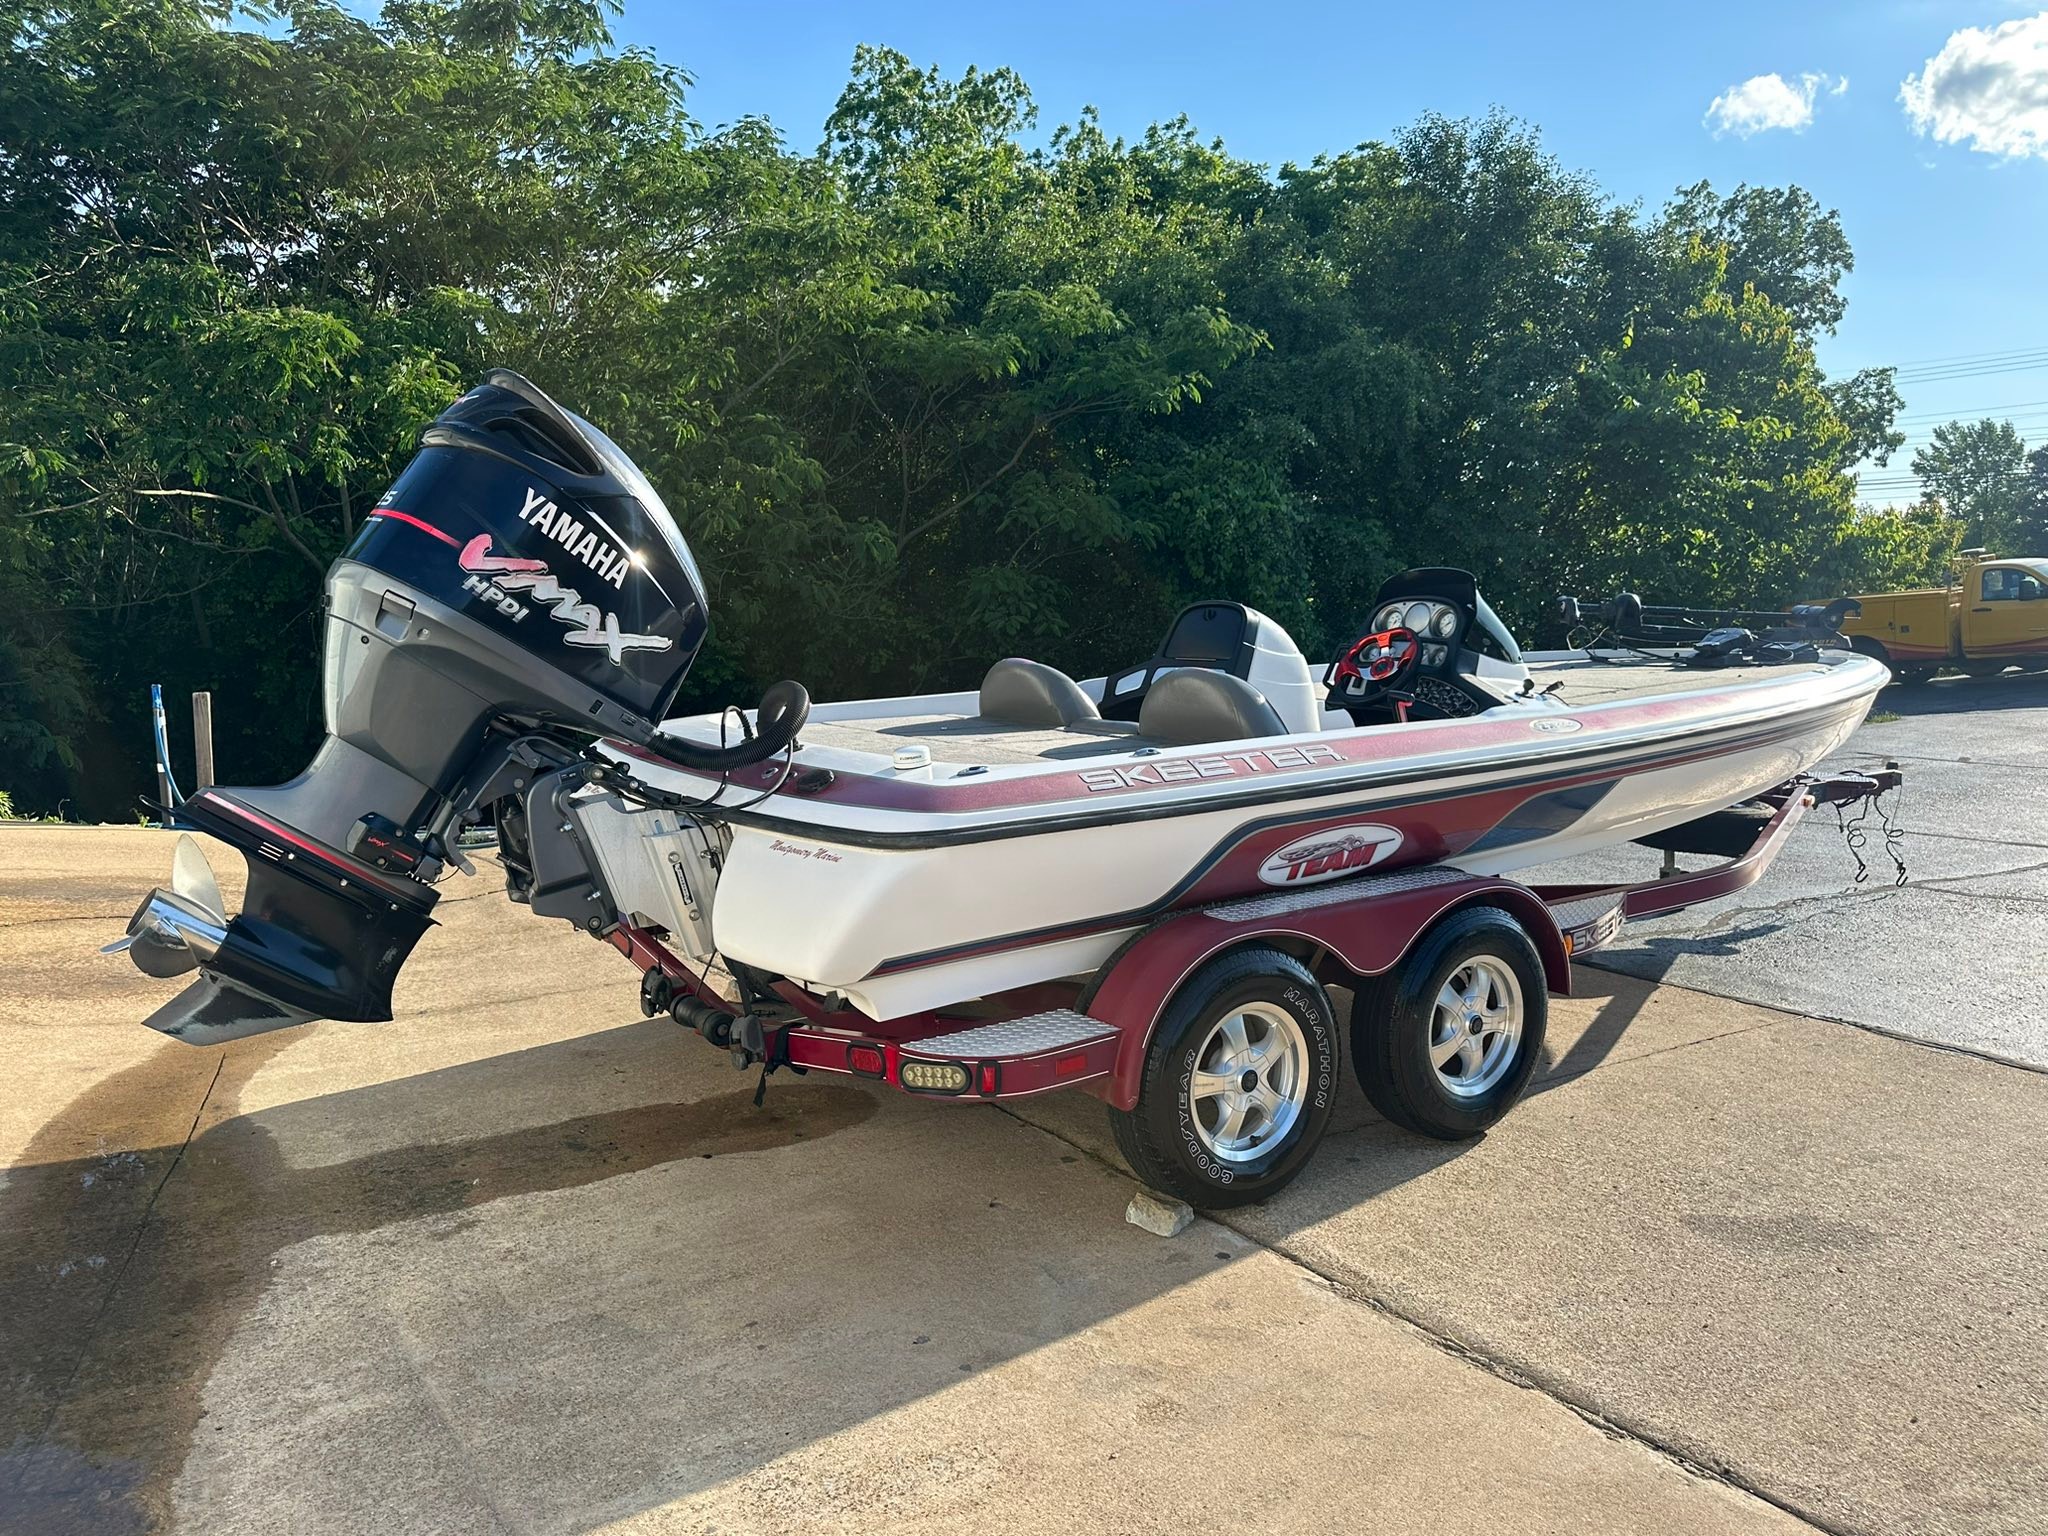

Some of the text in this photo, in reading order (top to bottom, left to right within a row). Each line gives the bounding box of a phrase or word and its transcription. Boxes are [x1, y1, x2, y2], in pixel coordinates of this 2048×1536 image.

[517, 487, 632, 591] YAMAHA
[461, 574, 530, 624] HPDI
[1078, 744, 1344, 792] SKEETER
[812, 847, 843, 863] Marine
[1286, 843, 1379, 881] TEAM
[1284, 986, 1331, 1109] MARATHON
[1179, 1049, 1234, 1184] GOODYEAR
